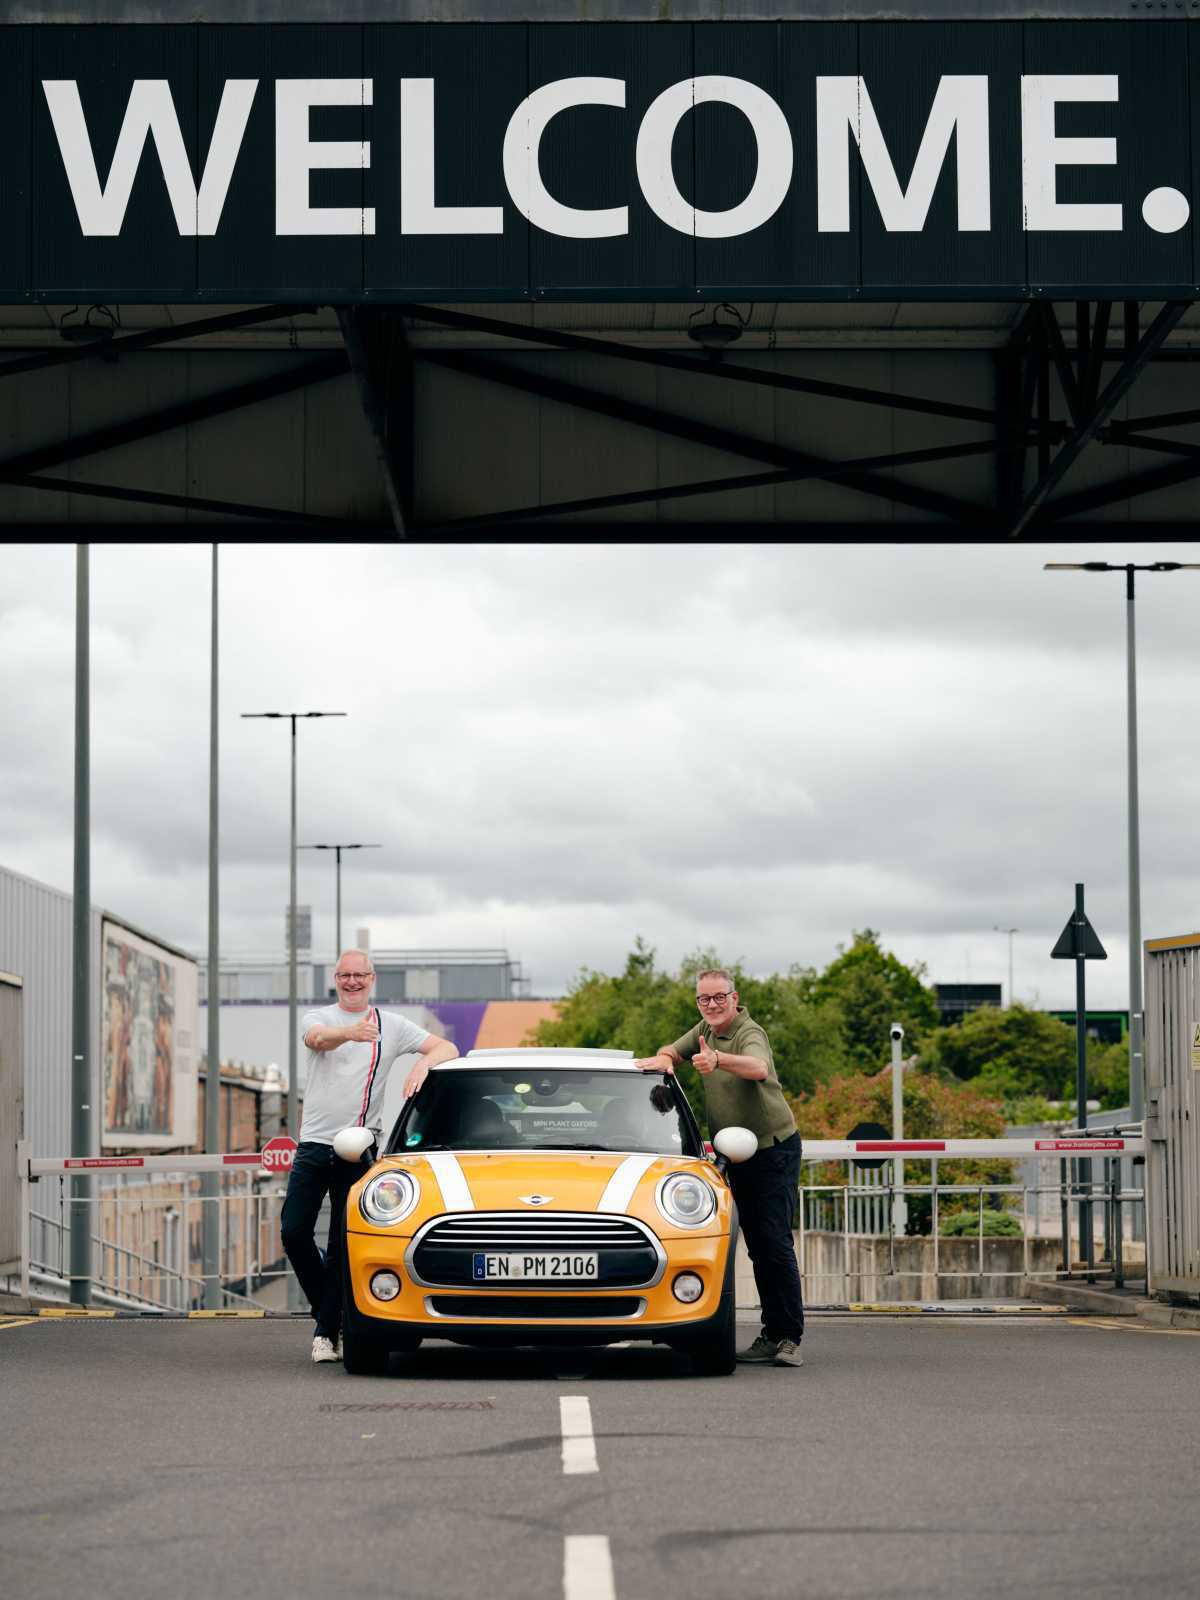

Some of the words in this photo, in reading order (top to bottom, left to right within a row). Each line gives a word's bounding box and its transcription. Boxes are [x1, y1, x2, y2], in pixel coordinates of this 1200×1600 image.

[42, 75, 1190, 238] WELCOME.
[486, 1257, 509, 1276] EN
[523, 1257, 546, 1276] PM
[550, 1257, 595, 1276] 2106
